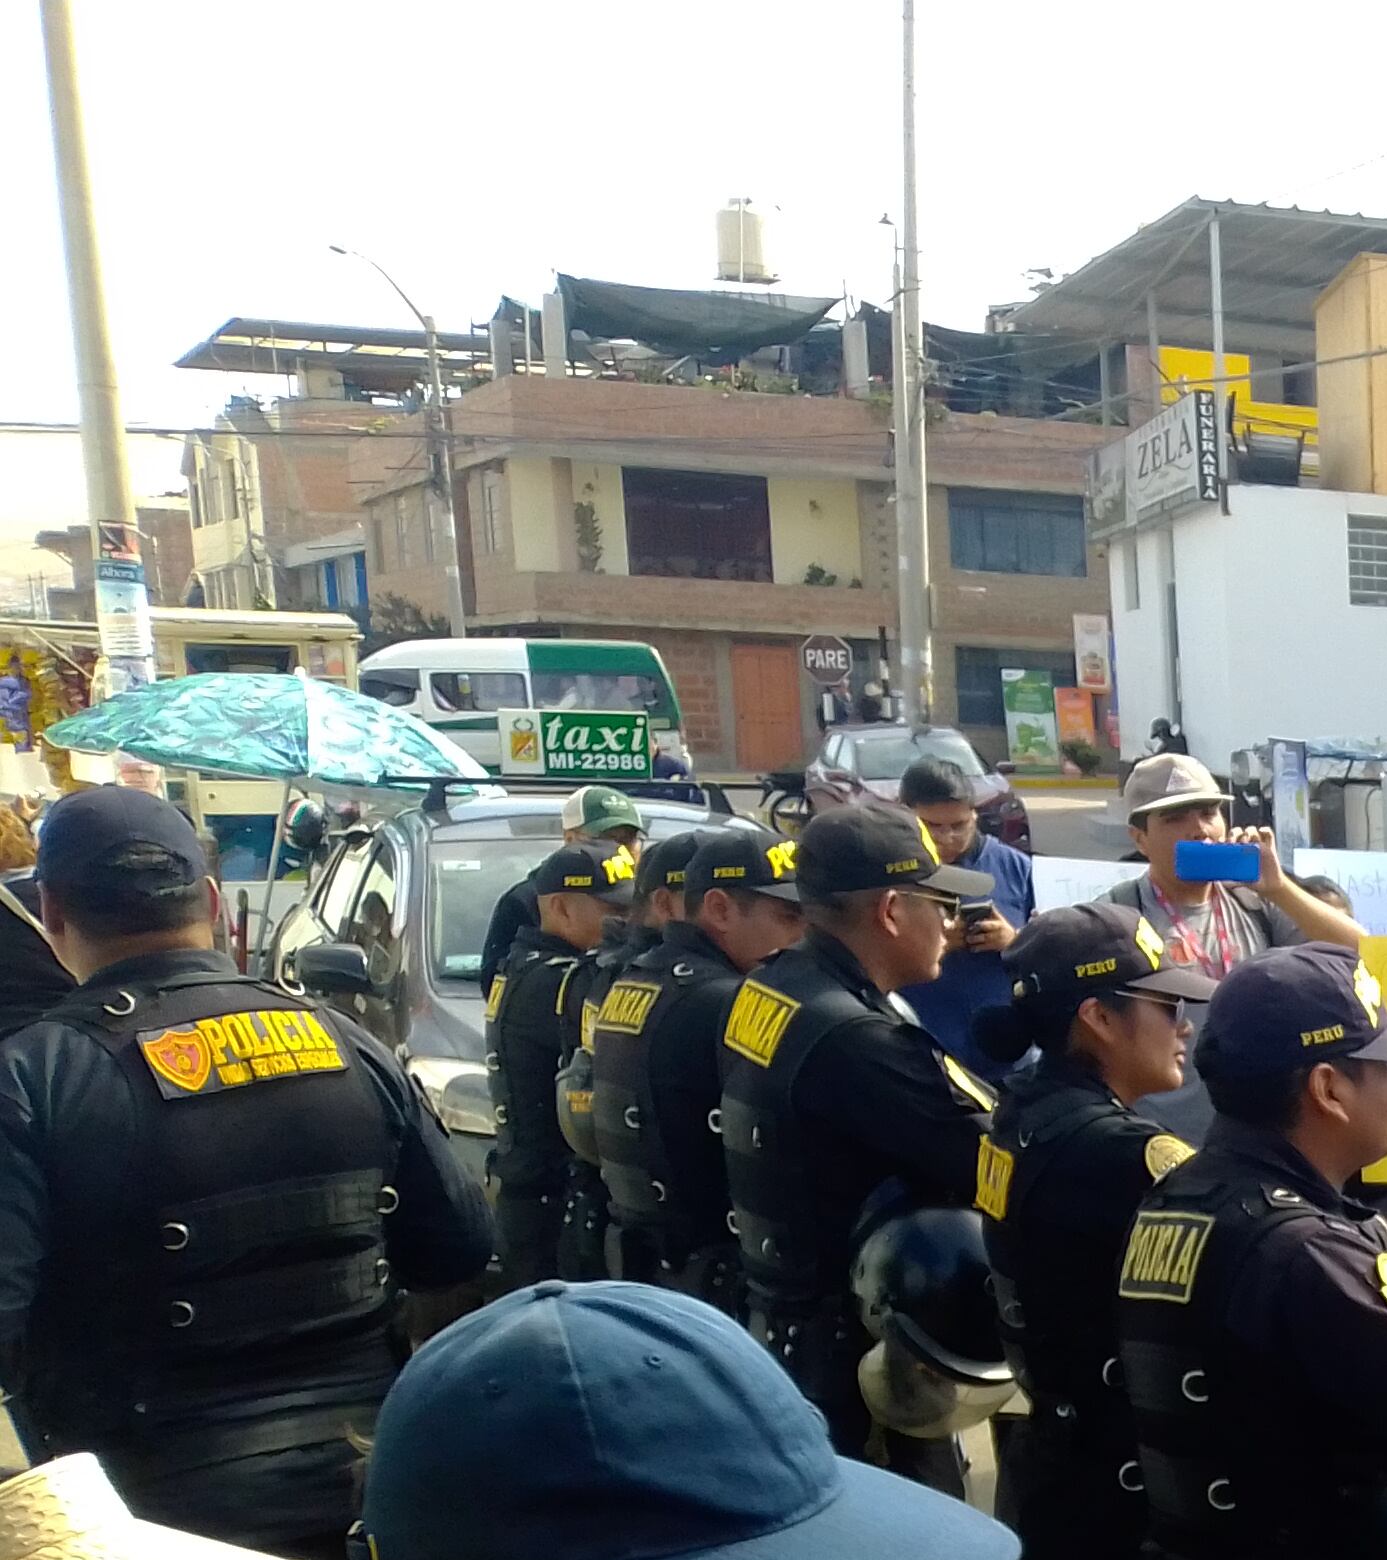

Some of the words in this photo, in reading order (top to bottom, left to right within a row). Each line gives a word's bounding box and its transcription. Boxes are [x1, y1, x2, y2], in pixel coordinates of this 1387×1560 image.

[1137, 417, 1194, 480] ZELA
[1199, 393, 1218, 499] FUNERARIA
[804, 649, 848, 670] PARE
[546, 715, 647, 752] taxi
[549, 752, 647, 771] MI-22986
[1073, 957, 1117, 979] PERU
[196, 1010, 338, 1066] POLICIA
[1299, 1024, 1346, 1047] PERU
